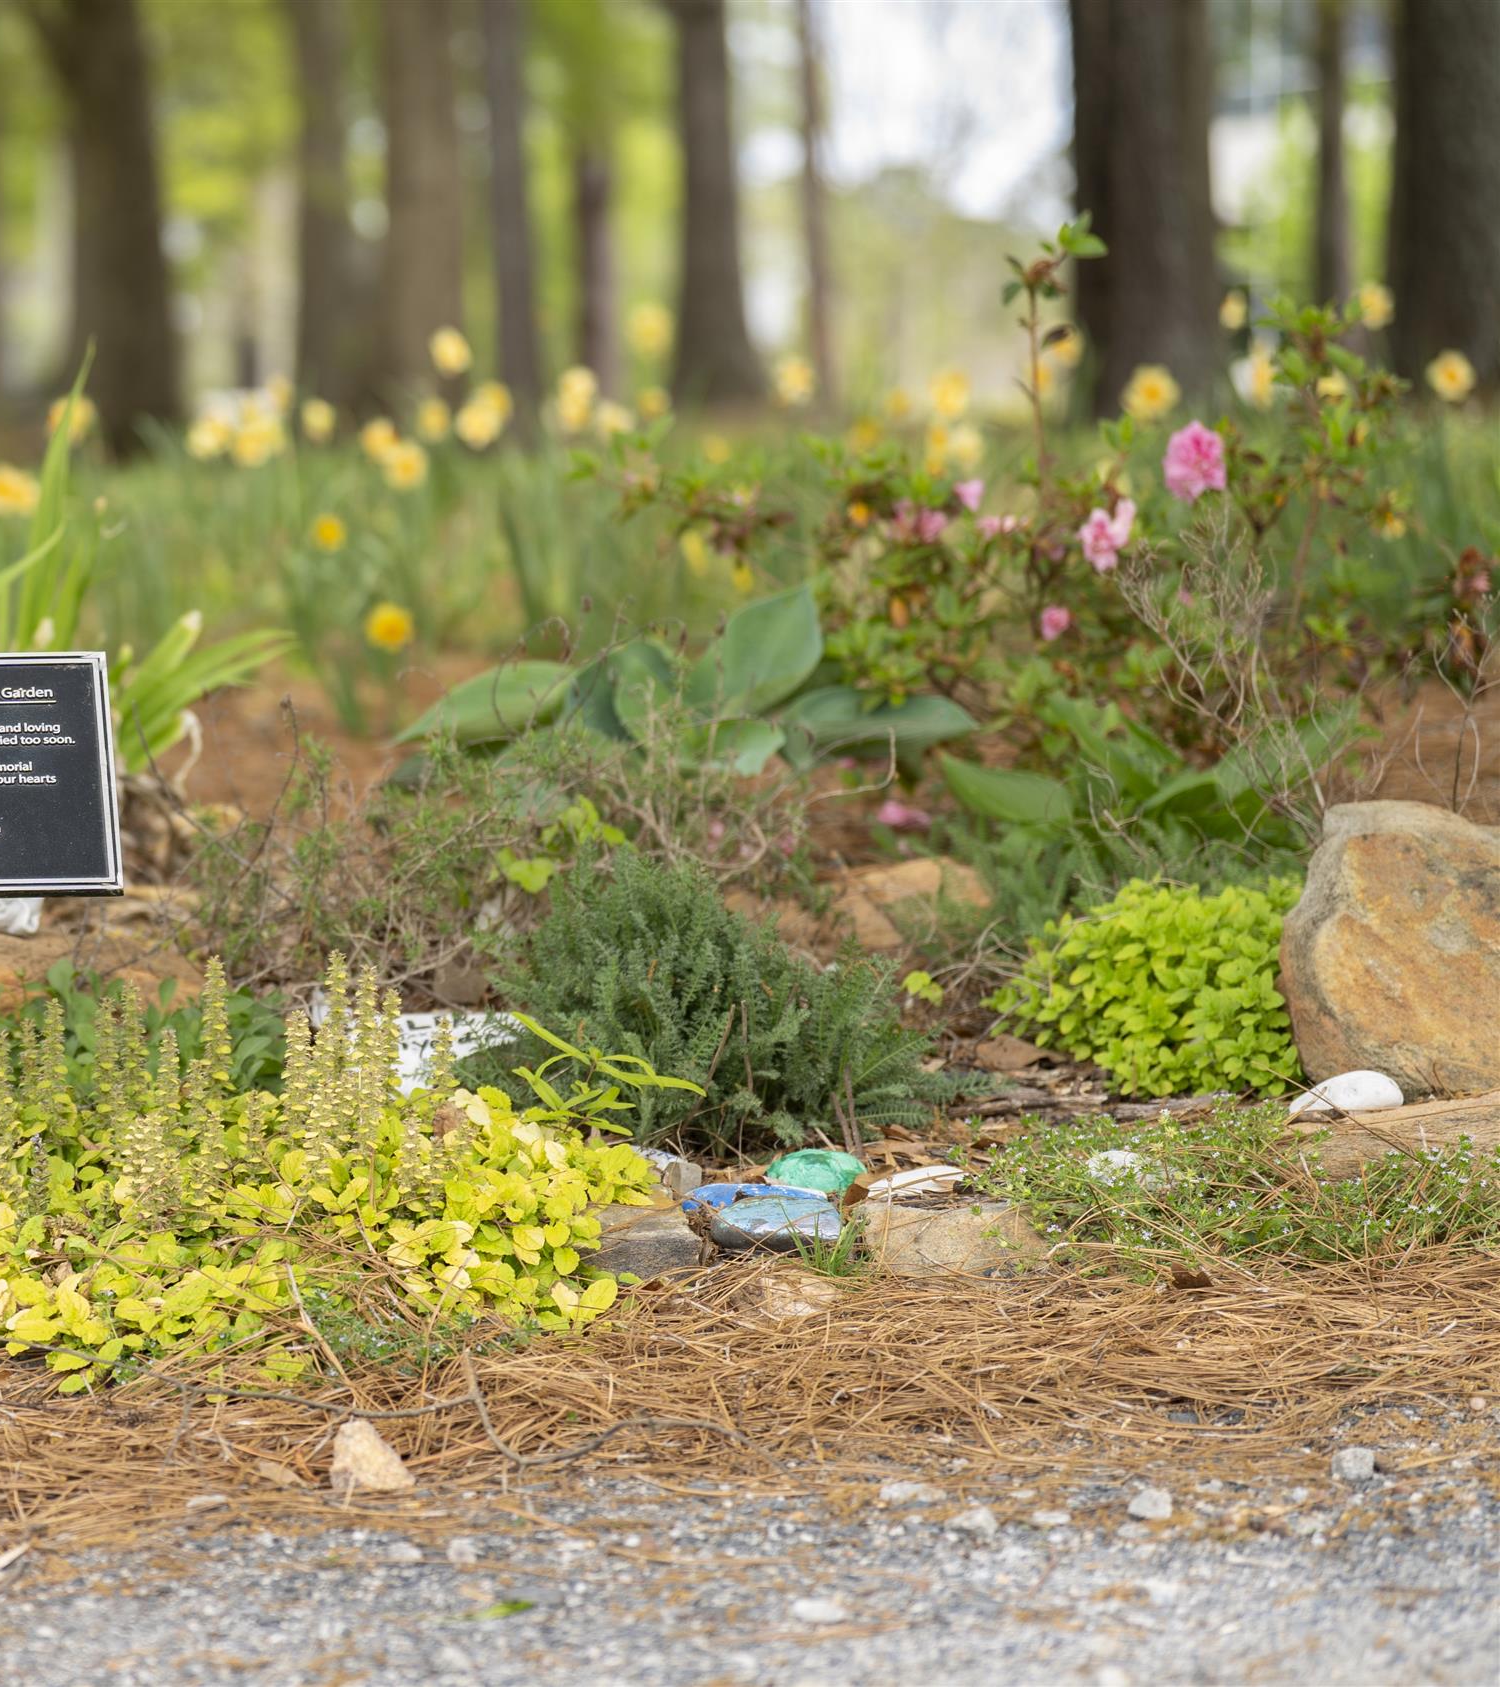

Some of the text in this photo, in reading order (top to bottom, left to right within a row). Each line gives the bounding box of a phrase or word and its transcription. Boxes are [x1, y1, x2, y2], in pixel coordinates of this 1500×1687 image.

[0, 687, 54, 698] Garden
[24, 723, 61, 735] loving
[20, 736, 41, 745] too
[43, 736, 76, 745] soon.
[18, 774, 56, 784] hearts
